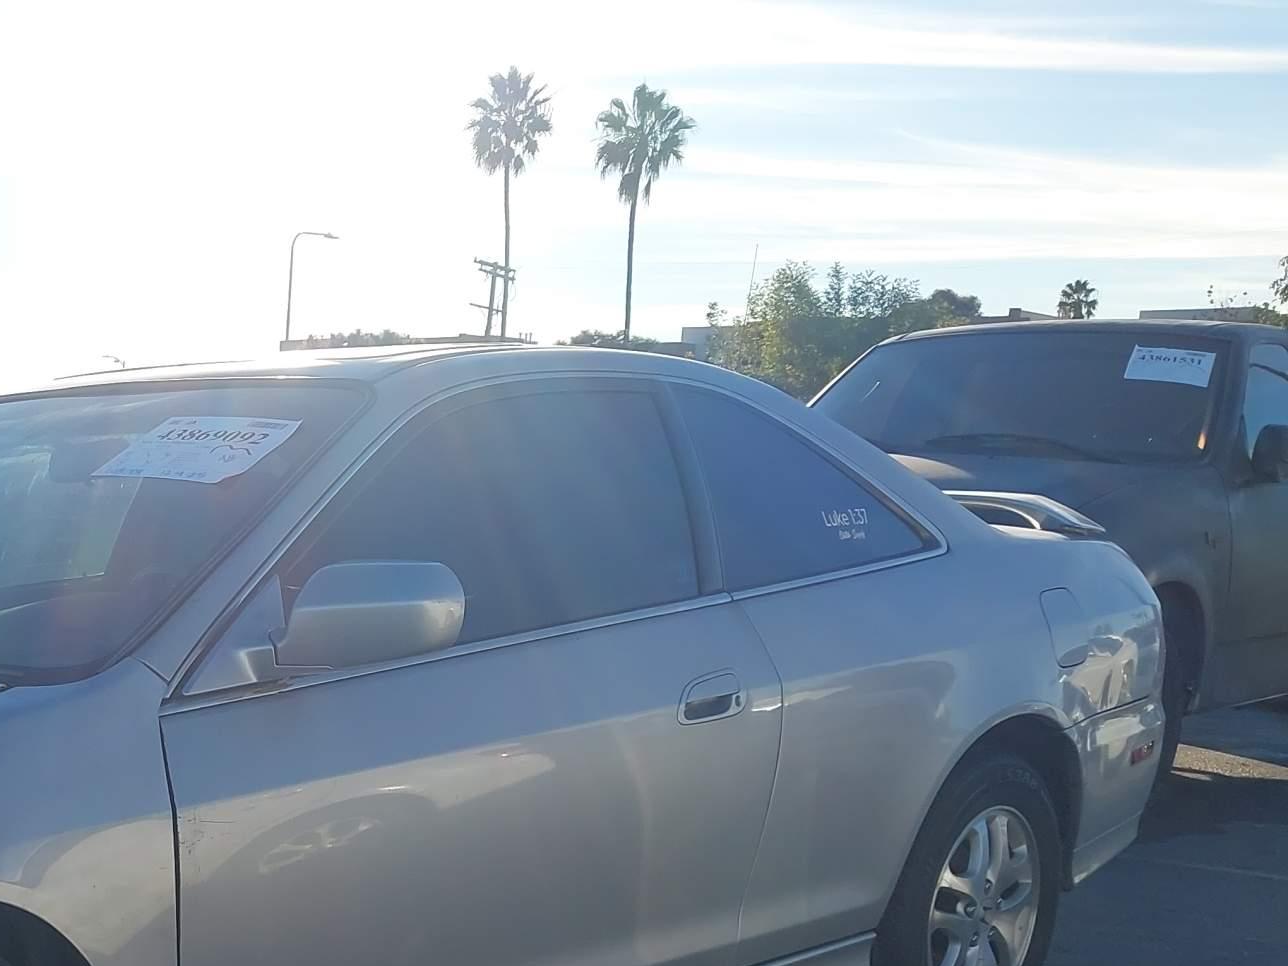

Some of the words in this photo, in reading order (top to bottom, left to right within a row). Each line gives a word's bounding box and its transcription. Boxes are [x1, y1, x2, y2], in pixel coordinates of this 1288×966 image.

[157, 428, 269, 445] 43869092
[821, 510, 850, 527] Luke
[847, 508, 868, 525] 1:37
